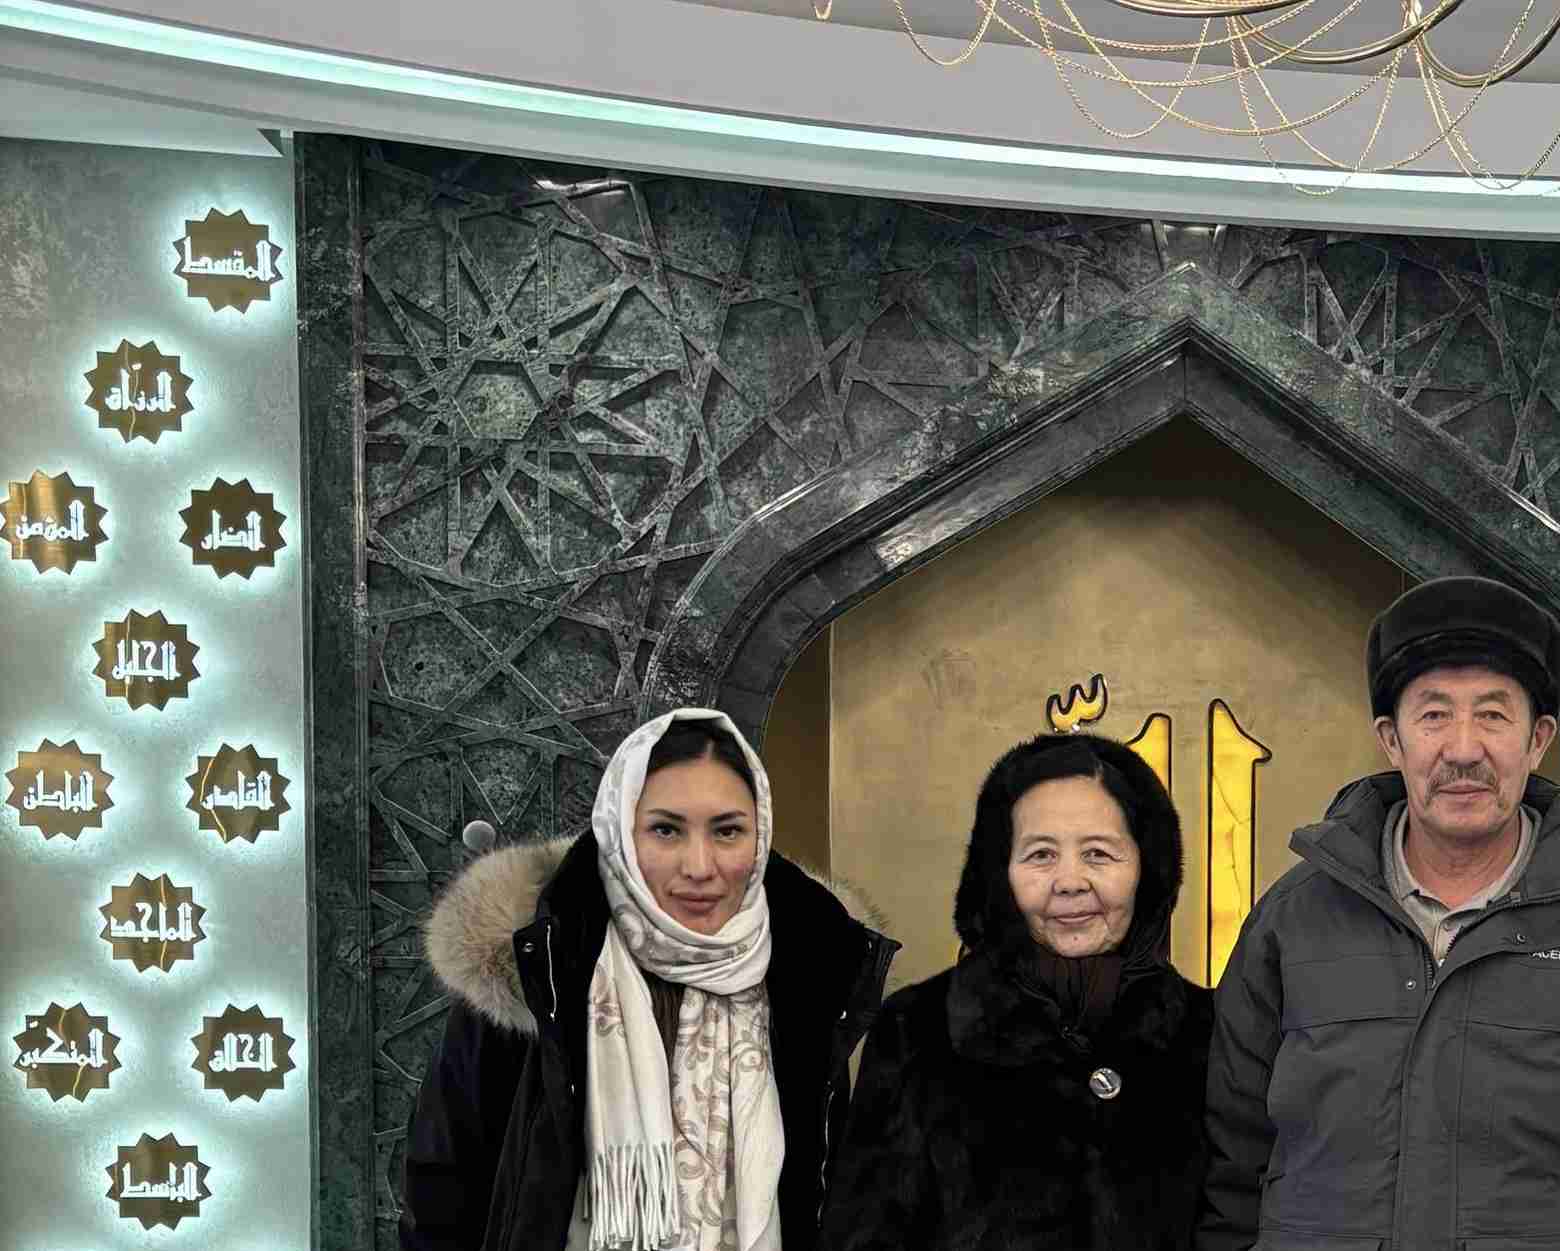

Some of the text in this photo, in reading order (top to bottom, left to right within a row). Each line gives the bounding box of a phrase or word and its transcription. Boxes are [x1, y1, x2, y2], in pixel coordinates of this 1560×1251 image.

[181, 235, 276, 282] المقسط
[112, 640, 182, 684] الجليل
[23, 769, 98, 812] الباطن
[110, 902, 197, 942] الماجد
[120, 1162, 202, 1203] الباسط
